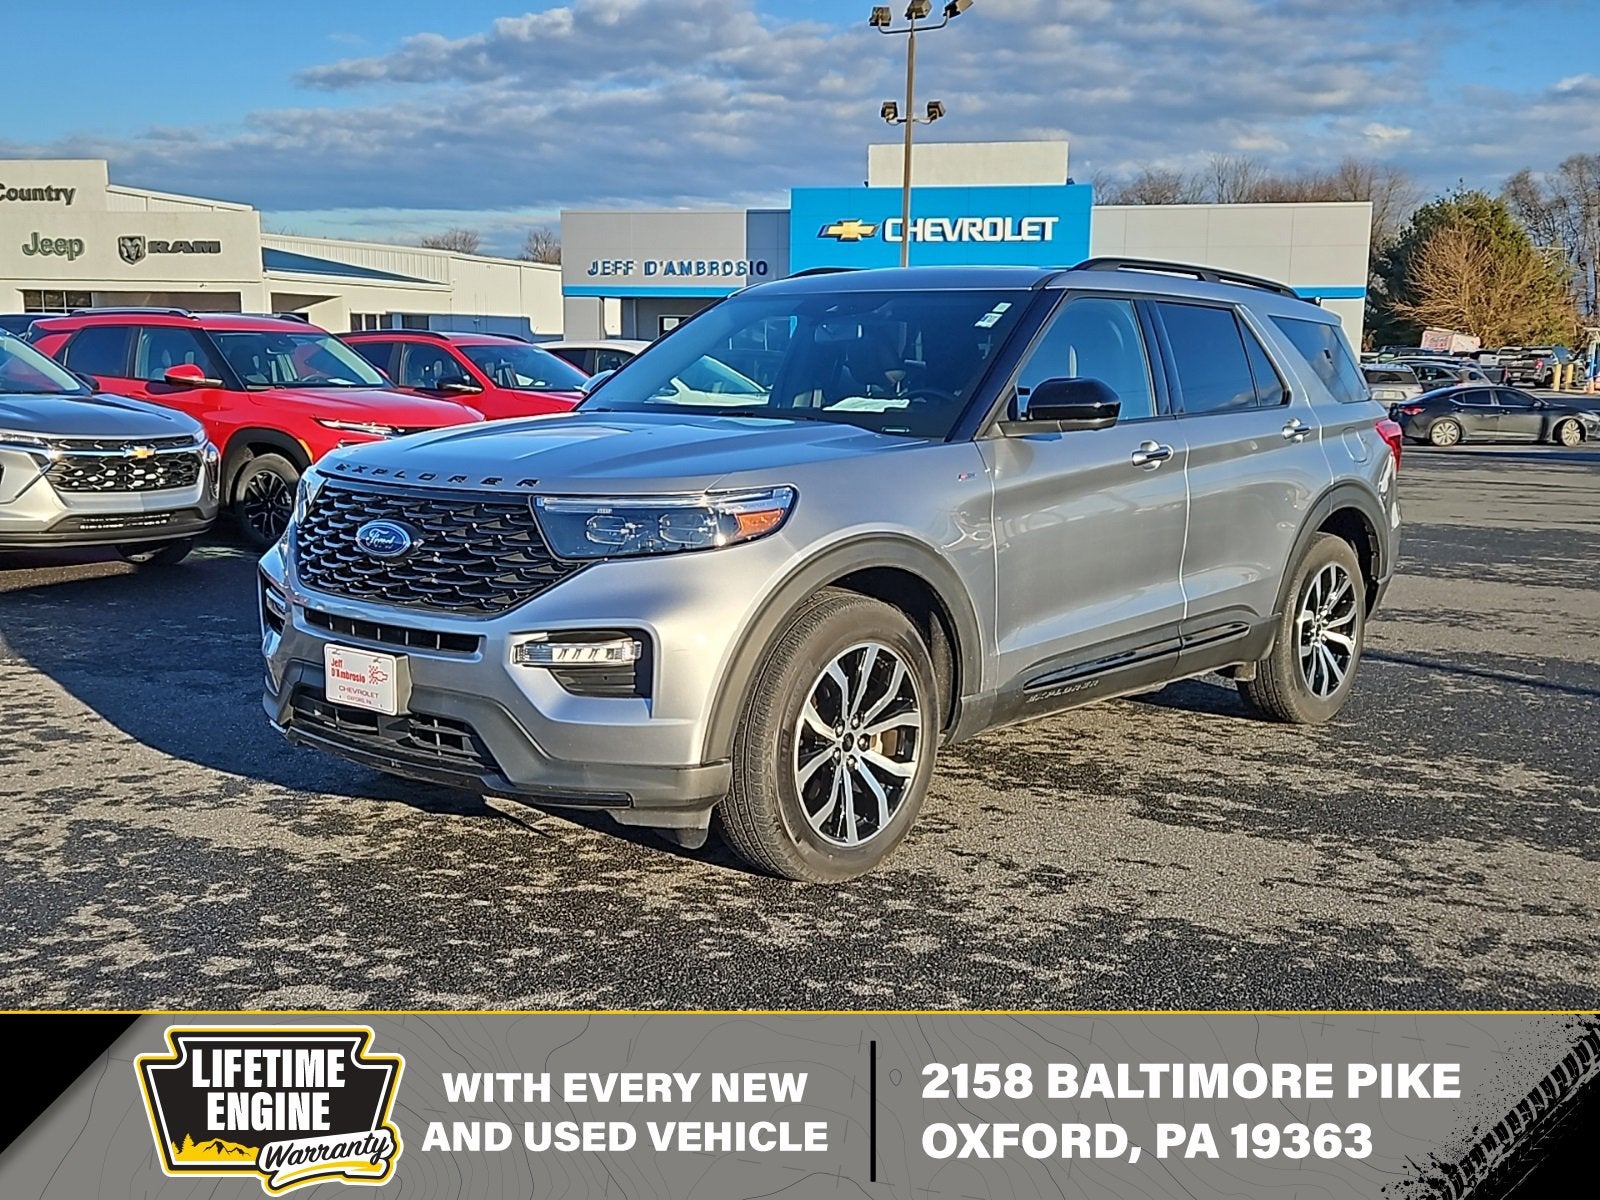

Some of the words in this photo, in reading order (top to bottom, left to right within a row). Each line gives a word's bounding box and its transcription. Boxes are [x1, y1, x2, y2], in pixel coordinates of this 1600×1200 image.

[883, 216, 1060, 242] CHEVROLET
[22, 232, 85, 261] Jeep
[148, 240, 221, 254] RAM
[587, 260, 635, 276] JEFF
[643, 260, 769, 276] D'AMBROSIO
[336, 462, 541, 487] EXPLORER
[365, 527, 396, 549] Ford
[331, 658, 343, 668] Jeff
[331, 667, 366, 684] D'Ambrosio
[339, 685, 379, 699] CHEVROLET
